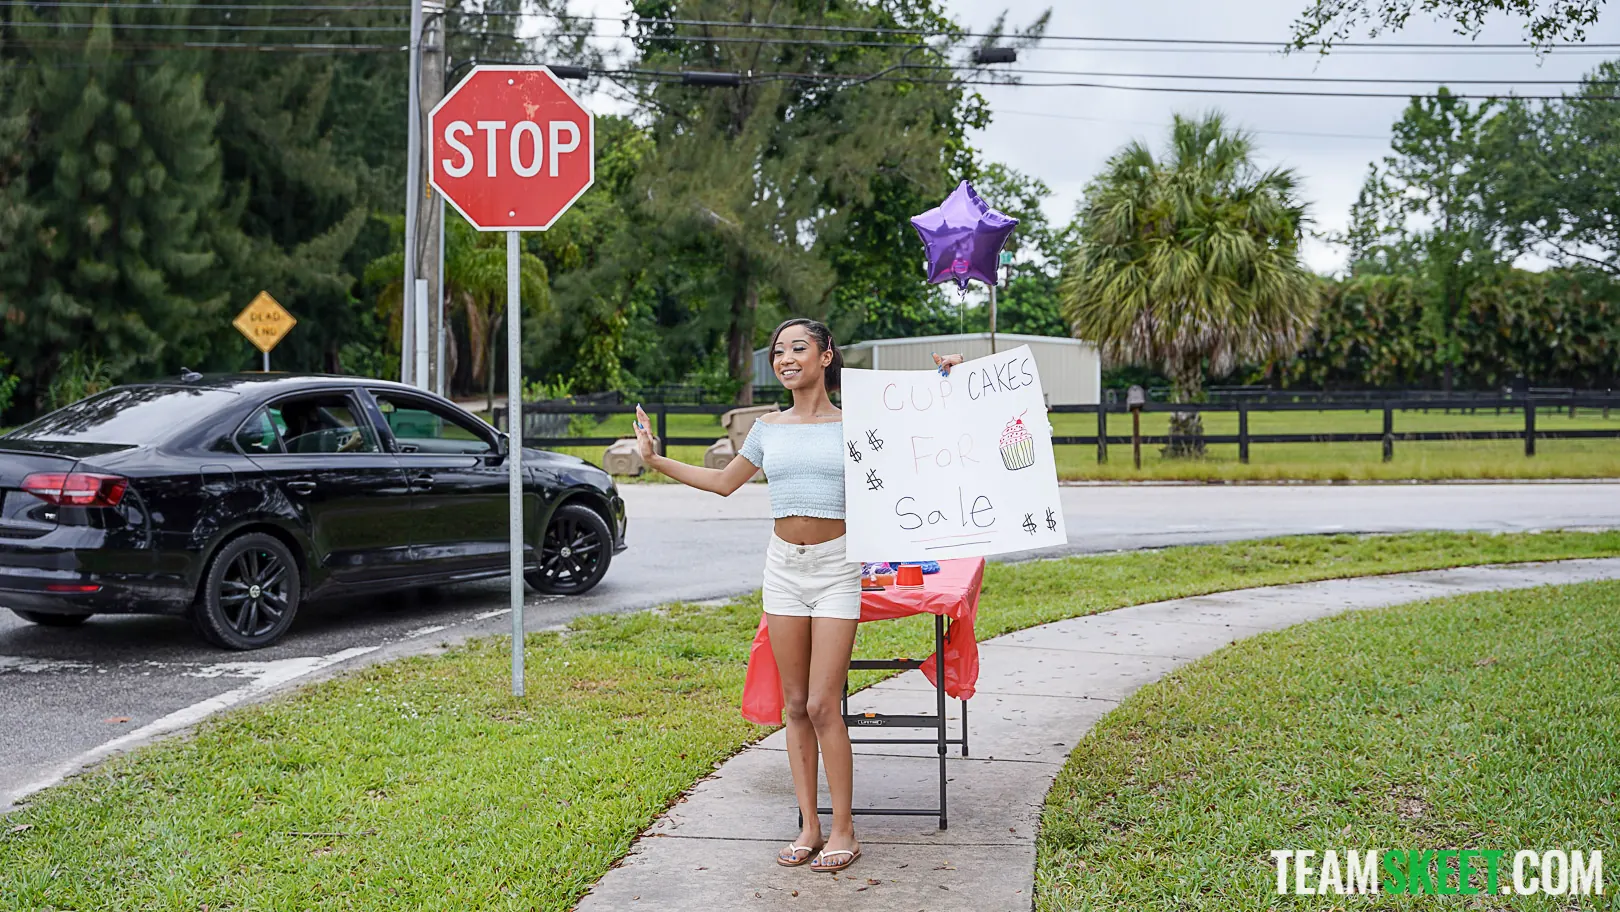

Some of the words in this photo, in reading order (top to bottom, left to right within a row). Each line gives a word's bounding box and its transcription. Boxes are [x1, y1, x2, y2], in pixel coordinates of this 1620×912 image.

[442, 120, 581, 178] STOP
[251, 311, 280, 322] DEAD
[255, 326, 277, 336] END
[883, 379, 953, 412] CUP
[968, 357, 1034, 401] CAKES
[847, 440, 862, 463] $
[865, 428, 884, 451] $
[866, 468, 884, 490] $
[895, 486, 996, 530] Sale
[1022, 512, 1037, 536] $
[1046, 506, 1057, 532] $
